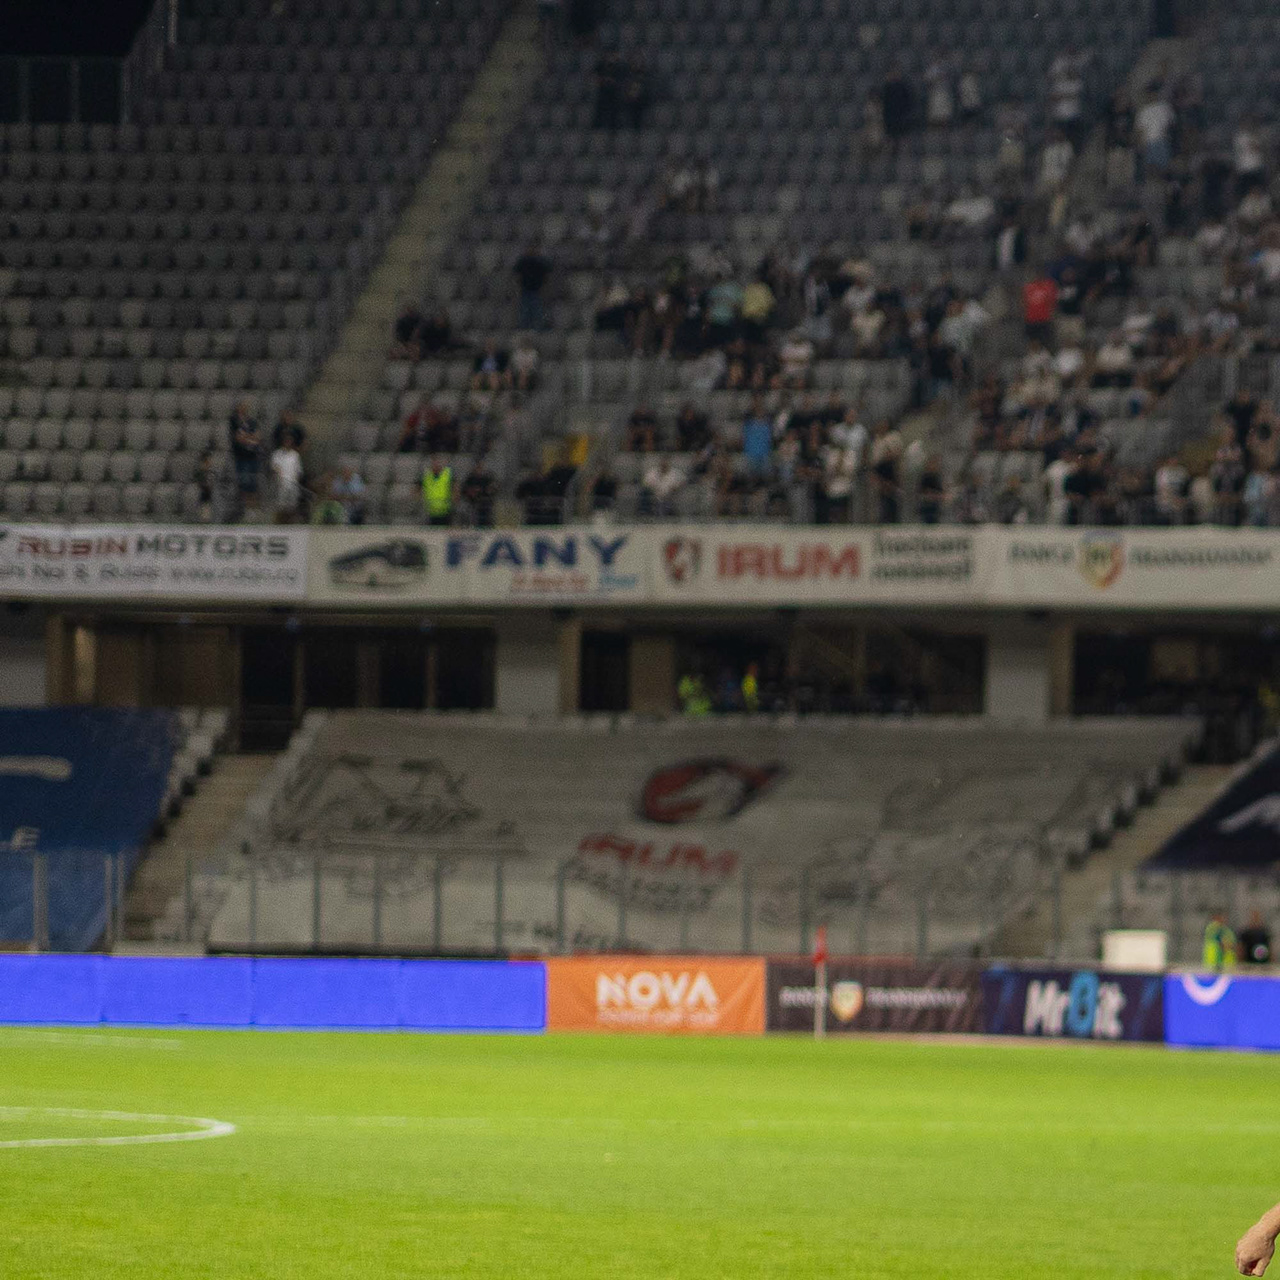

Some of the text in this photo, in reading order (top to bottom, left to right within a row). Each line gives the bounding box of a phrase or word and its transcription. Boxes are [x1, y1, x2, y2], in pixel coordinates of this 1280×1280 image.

[136, 534, 290, 558] MOTORS
[446, 535, 628, 568] FANY
[717, 543, 860, 579] IRUM
[596, 970, 719, 1007] NOVA
